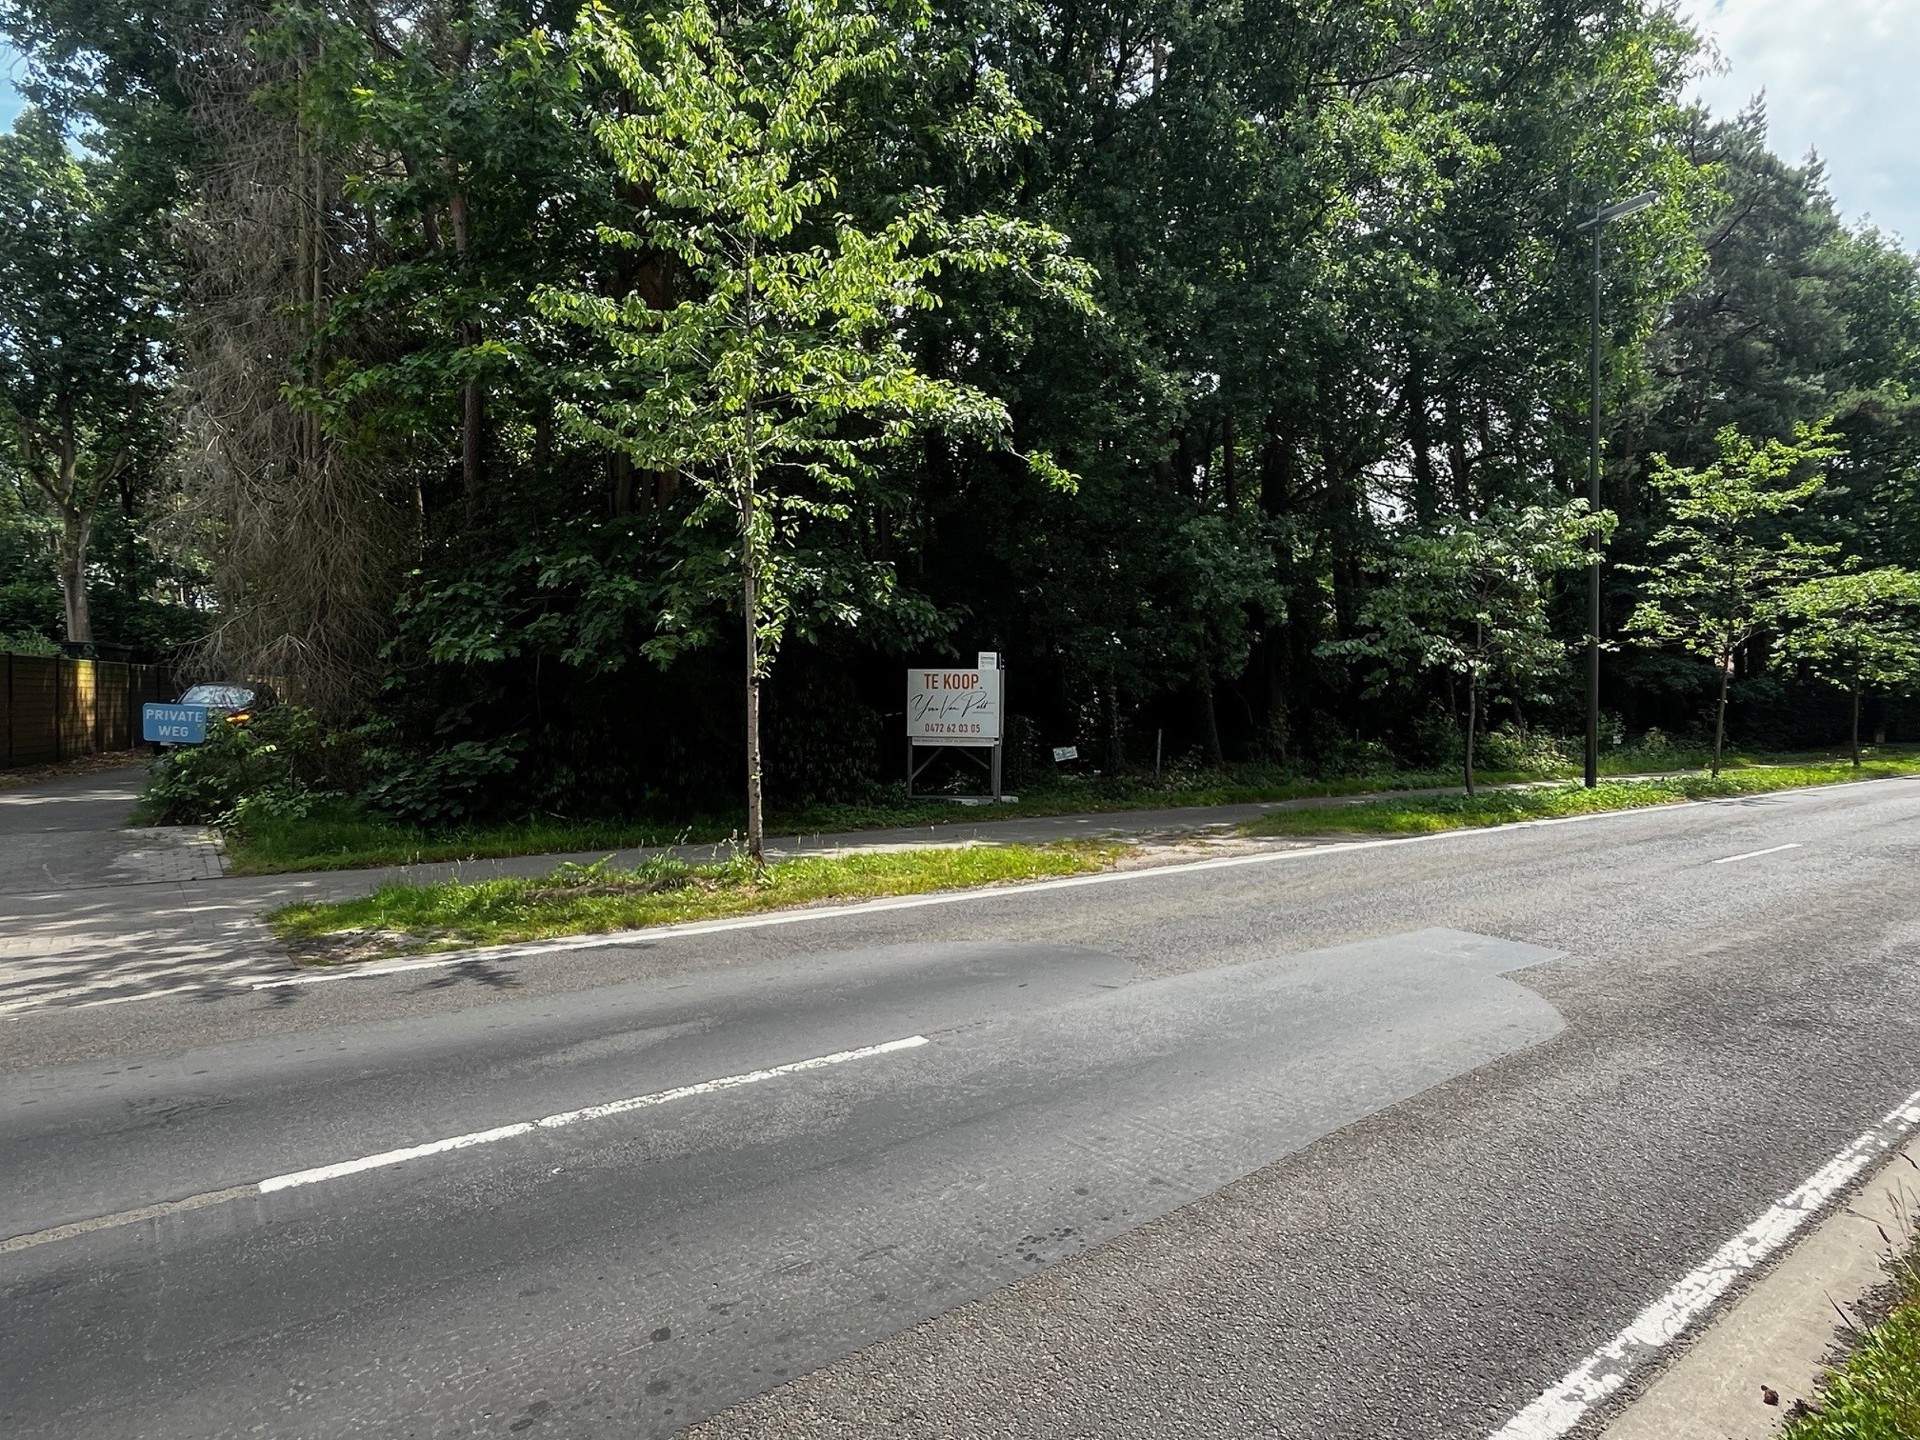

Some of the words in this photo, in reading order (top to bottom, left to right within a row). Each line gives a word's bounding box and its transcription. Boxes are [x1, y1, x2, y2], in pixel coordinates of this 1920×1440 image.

[924, 673, 939, 689] TE
[145, 709, 204, 723] PRIVATE
[158, 725, 189, 737] WEG
[924, 723, 944, 733] 0472
[946, 723, 956, 733] 62
[958, 723, 969, 733] 03
[970, 723, 981, 733] 05
